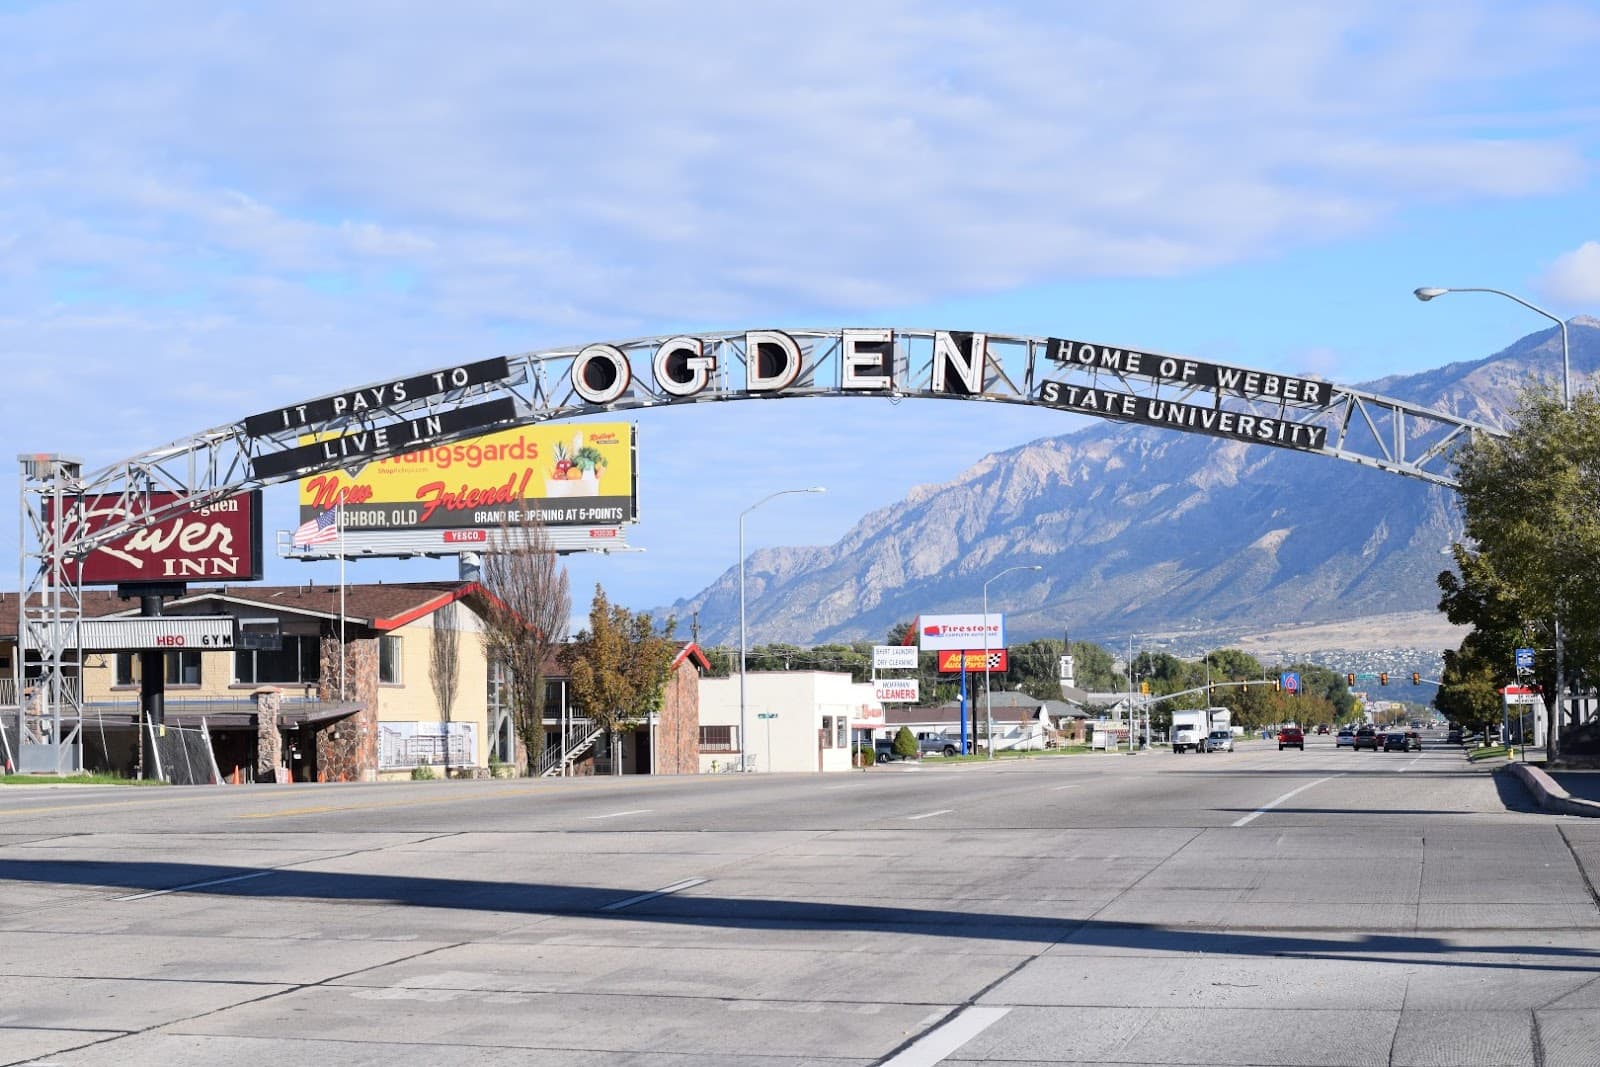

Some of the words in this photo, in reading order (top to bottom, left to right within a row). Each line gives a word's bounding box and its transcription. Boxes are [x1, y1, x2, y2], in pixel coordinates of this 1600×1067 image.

[571, 328, 987, 404] OGDEN
[1057, 340, 1142, 373] HOME
[1159, 358, 1198, 381] OF
[1217, 367, 1321, 403] WEBER
[282, 405, 307, 428] IT
[333, 382, 407, 415] PAYS
[432, 367, 469, 392] TO
[1043, 382, 1137, 416] STATE
[1148, 402, 1324, 447] UNIVERSITY
[324, 428, 389, 459] LIVE
[412, 415, 442, 439] IN
[380, 435, 538, 469] angsgards
[306, 475, 373, 511] New
[416, 467, 533, 522] Friend!
[336, 510, 390, 528] IGHBOR,
[391, 509, 417, 526] OLD
[474, 510, 507, 523] GRAND
[507, 509, 564, 522] RE-OPENING
[565, 508, 577, 521] AT
[579, 507, 623, 521] 5-POINTS
[162, 556, 240, 576] INN
[157, 635, 185, 646] HBO
[941, 625, 999, 634] Firestone
[876, 689, 916, 700] CLEANERS
